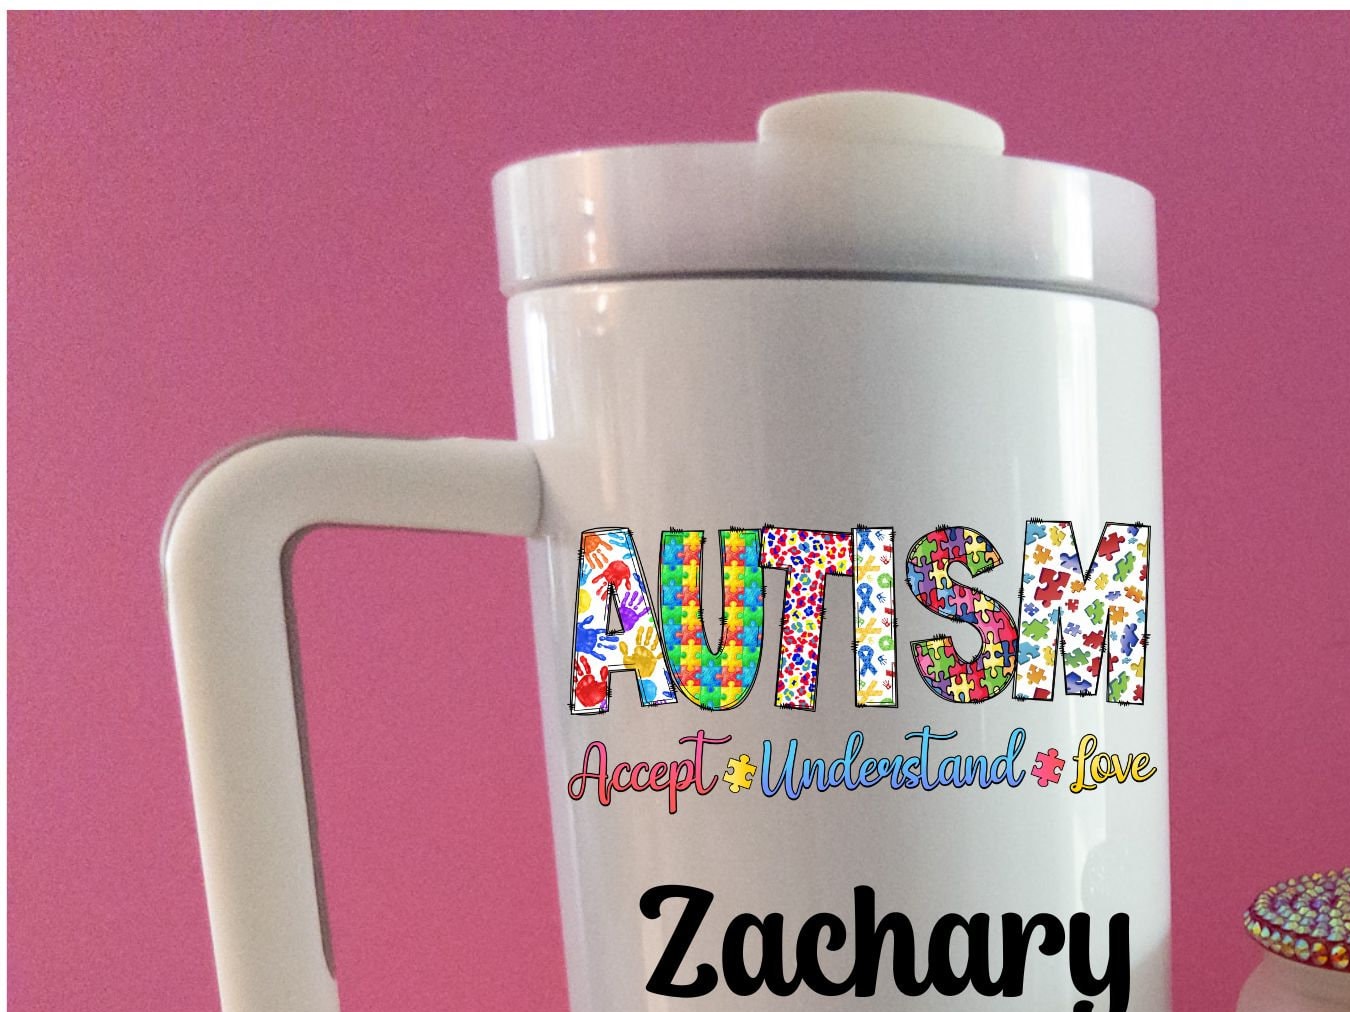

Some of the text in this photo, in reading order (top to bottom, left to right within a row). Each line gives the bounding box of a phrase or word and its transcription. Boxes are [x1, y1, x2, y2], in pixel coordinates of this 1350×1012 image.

[569, 518, 1152, 715] AUTISM
[567, 725, 1158, 815] Accept Understand Love
